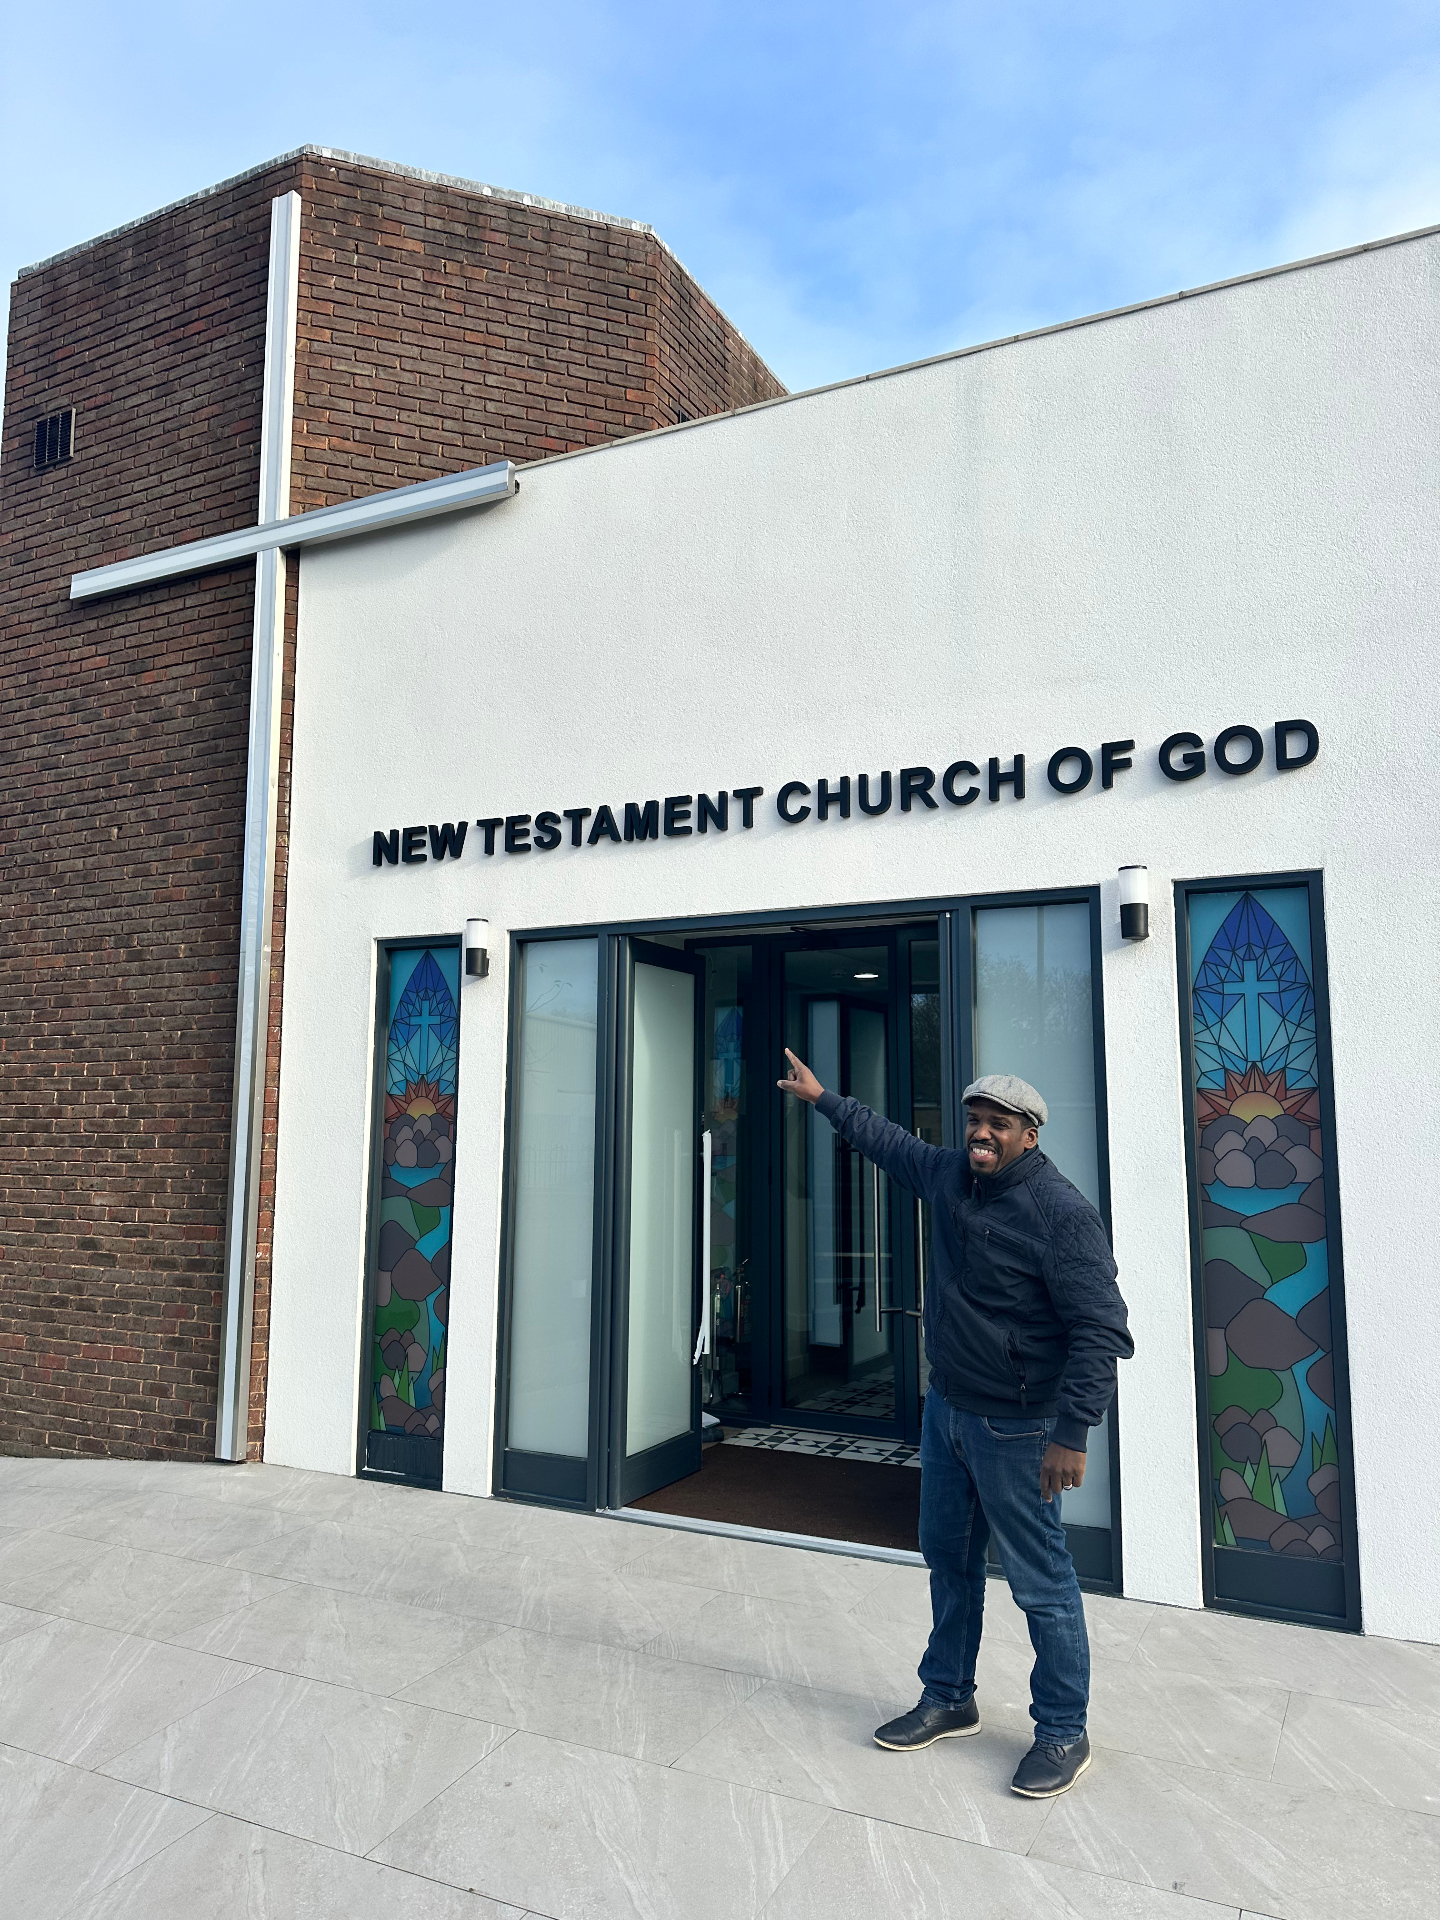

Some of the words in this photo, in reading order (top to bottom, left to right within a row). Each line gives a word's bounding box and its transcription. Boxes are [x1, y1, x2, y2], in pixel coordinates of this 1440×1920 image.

[372, 820, 468, 868] NEW
[476, 786, 764, 857] TESTAMENT
[776, 753, 1026, 825] CHURCH
[1046, 739, 1136, 796] OF
[1158, 719, 1320, 783] GOD
